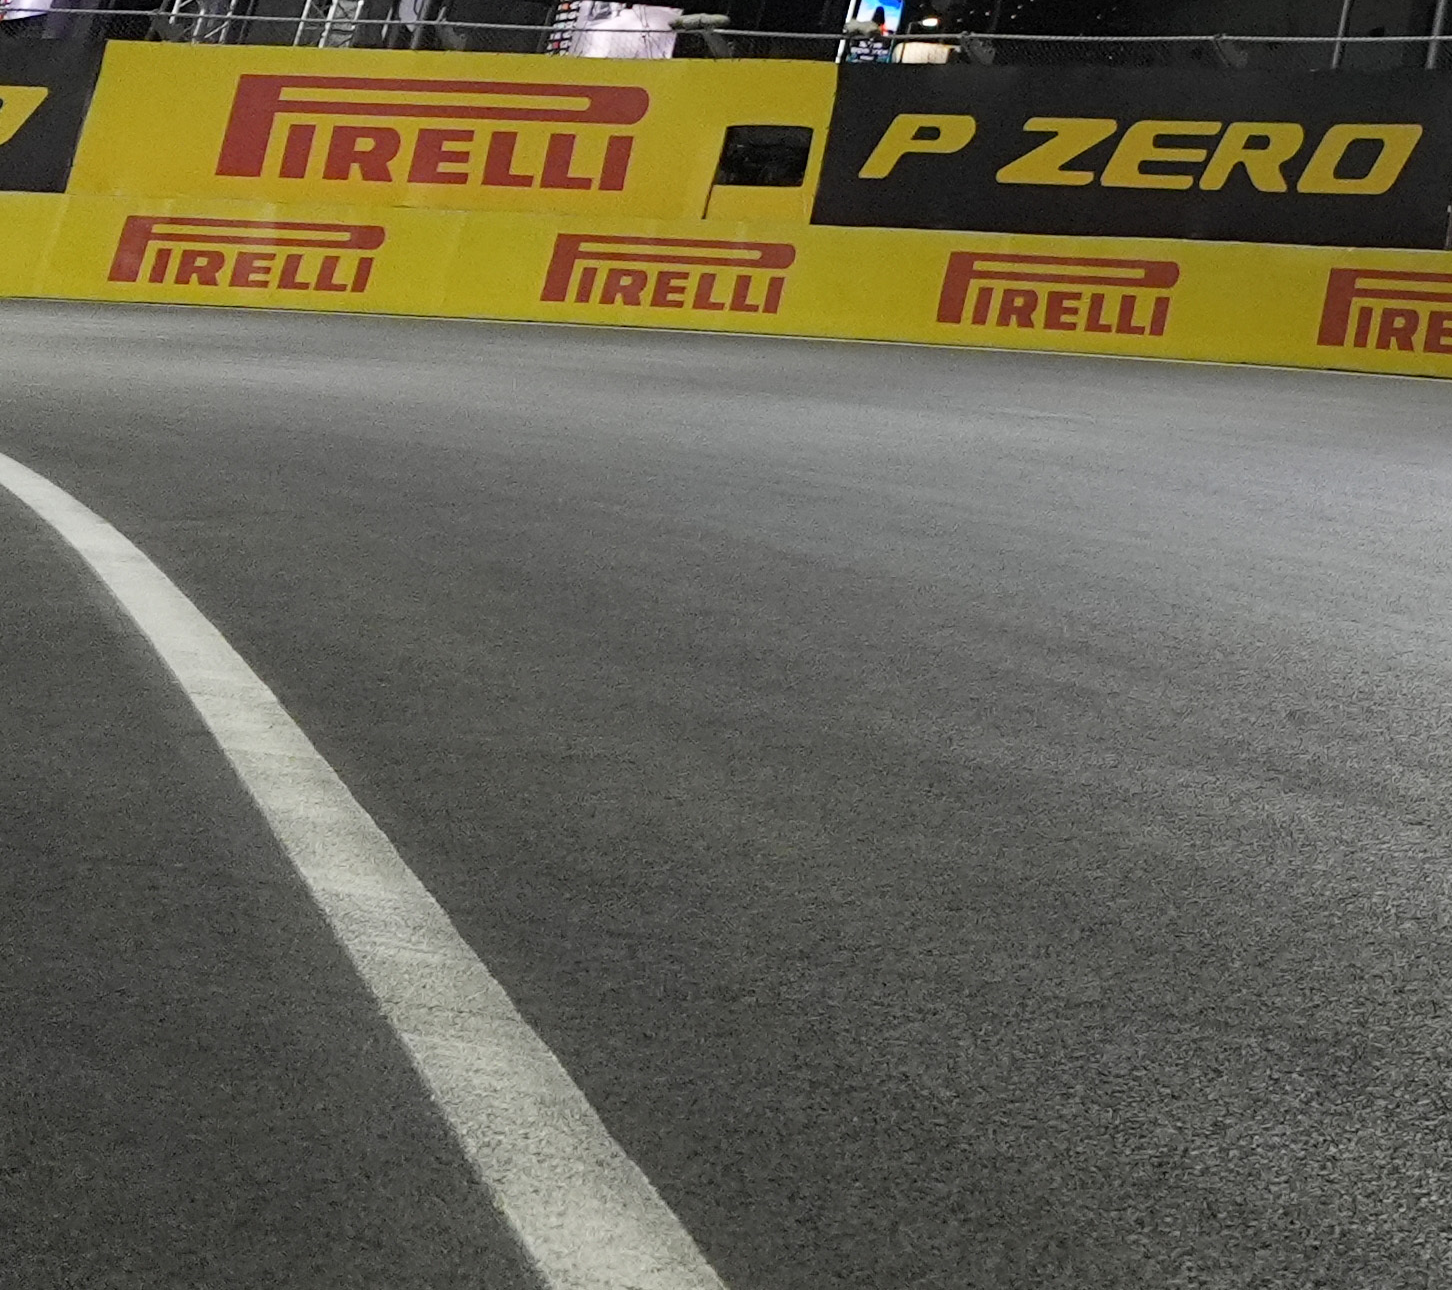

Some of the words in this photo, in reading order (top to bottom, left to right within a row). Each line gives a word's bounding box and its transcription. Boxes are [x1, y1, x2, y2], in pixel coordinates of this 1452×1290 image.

[216, 72, 650, 191] PIRELLI
[860, 113, 976, 179] P
[996, 116, 1424, 195] ZERO
[108, 215, 387, 294] PIRELLI
[541, 233, 796, 314] PIRELLI
[936, 251, 1180, 337] PIRELLI
